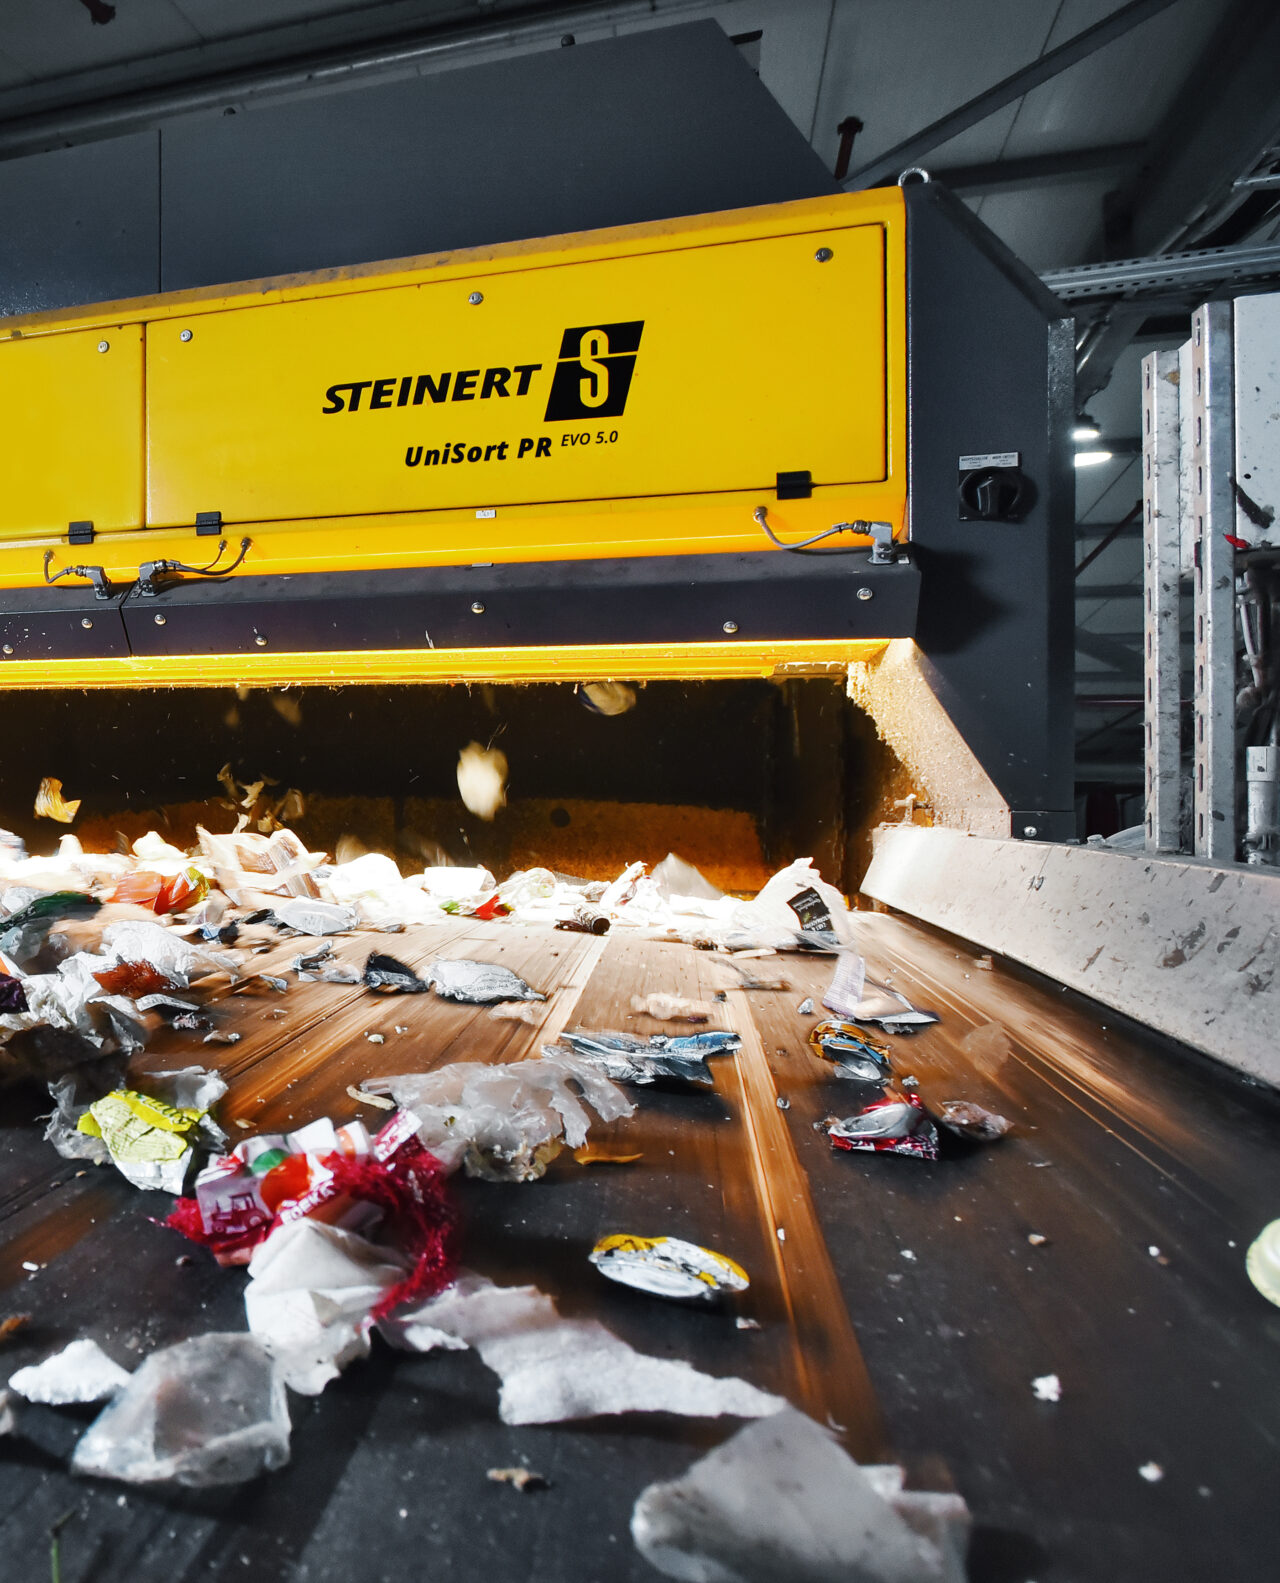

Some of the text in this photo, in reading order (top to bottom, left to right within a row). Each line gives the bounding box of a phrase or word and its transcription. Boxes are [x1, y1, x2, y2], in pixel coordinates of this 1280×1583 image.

[323, 363, 543, 414] STEINERT
[405, 430, 619, 467] UniSort PR EVO 5.0
